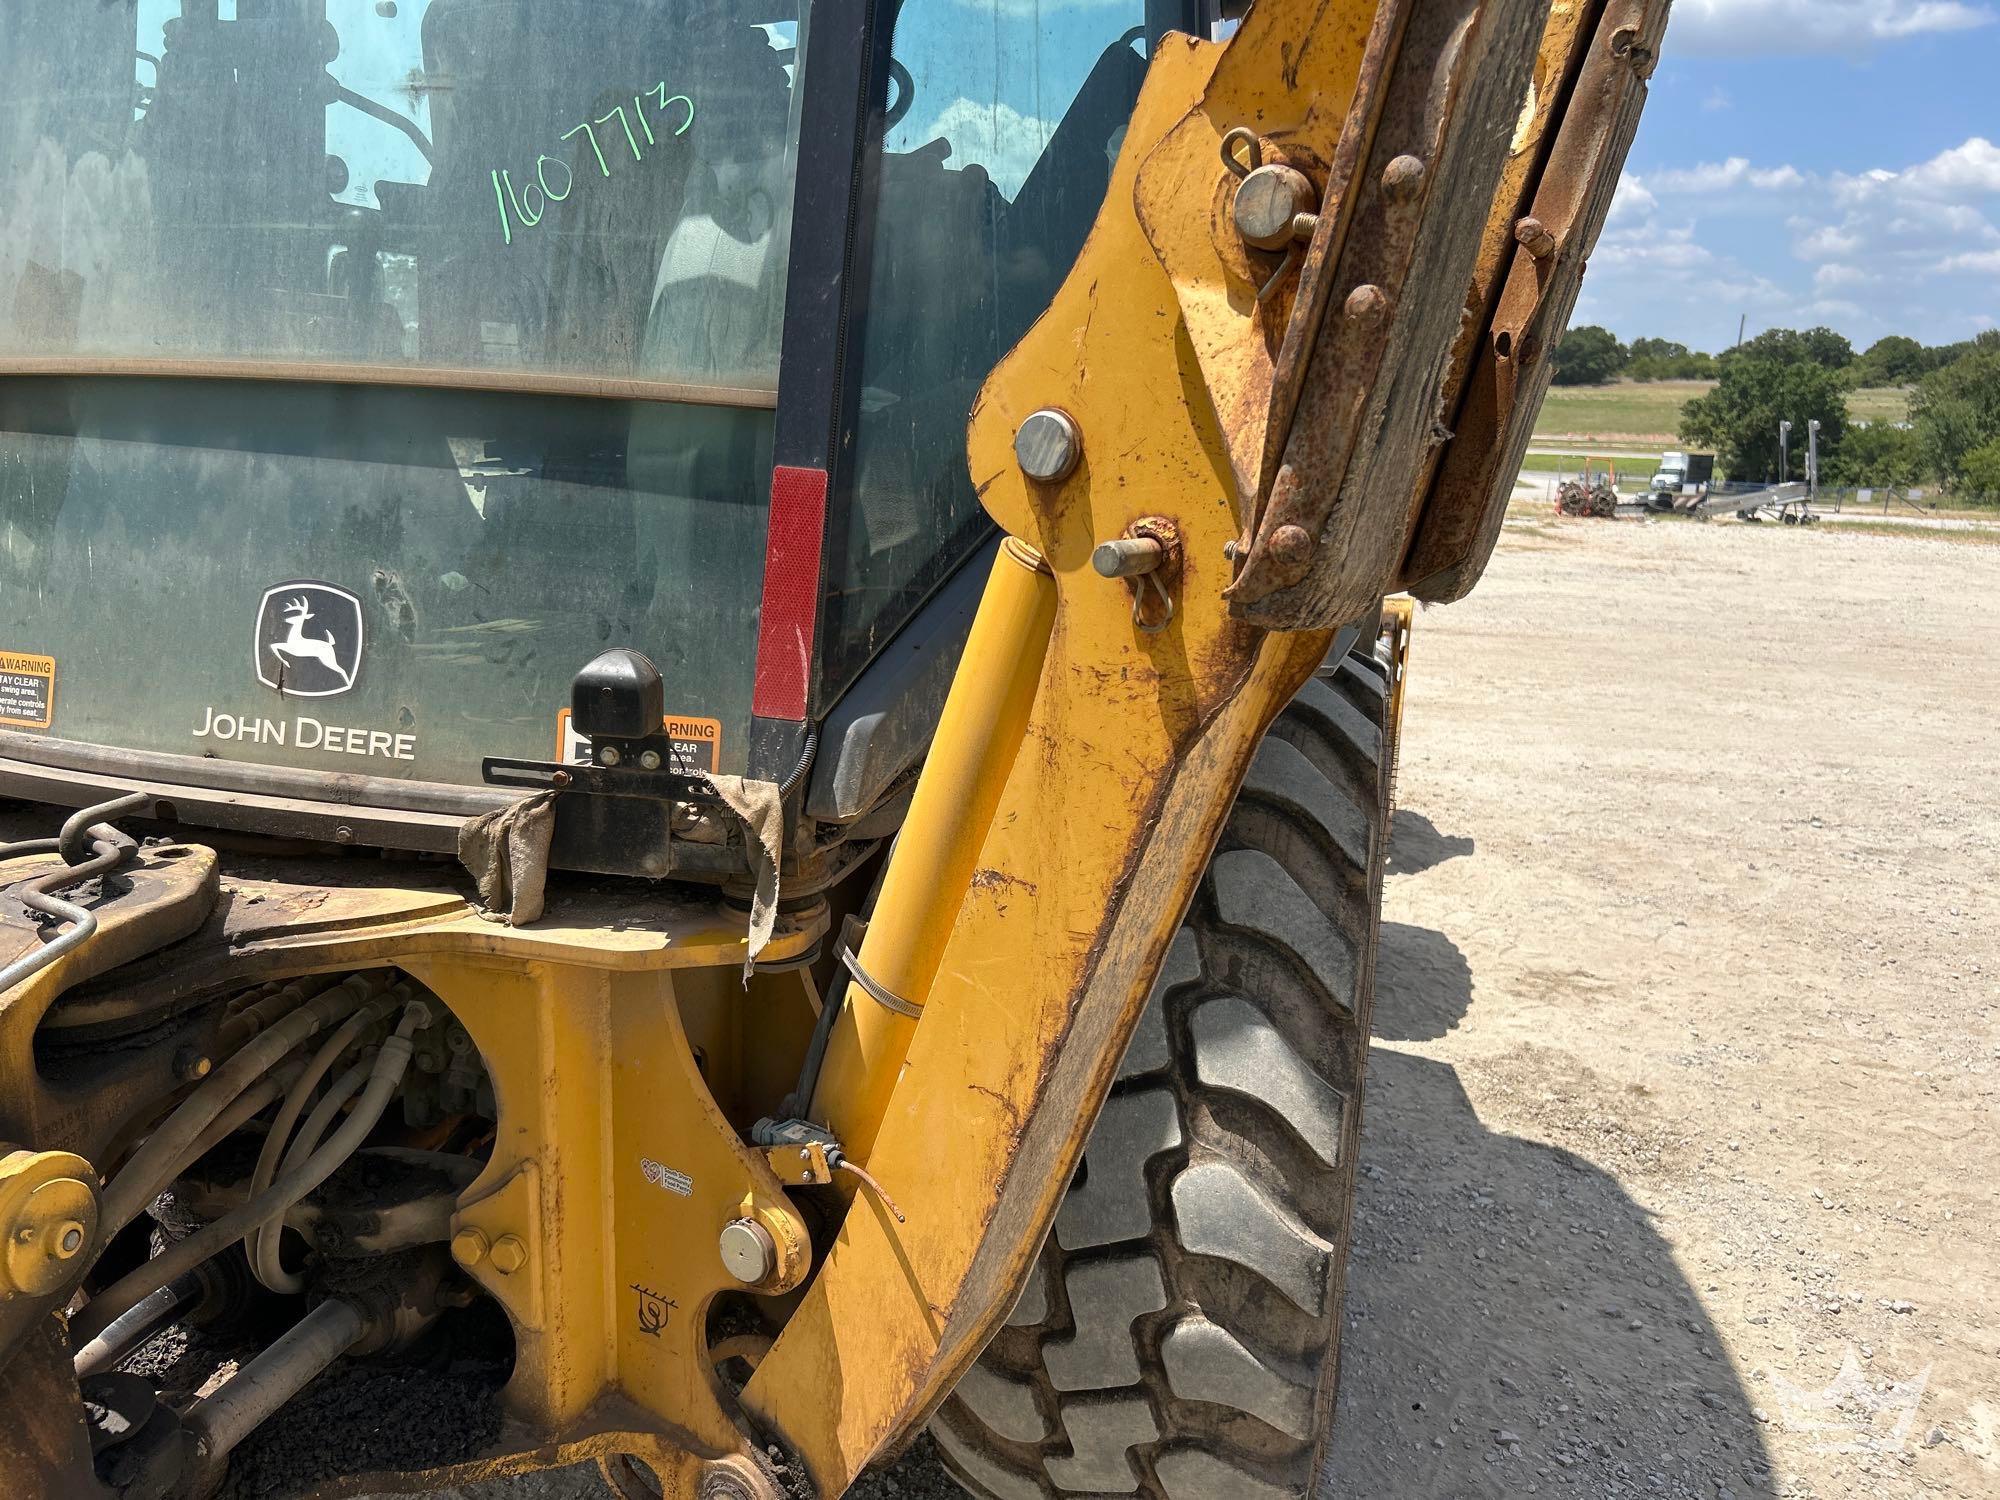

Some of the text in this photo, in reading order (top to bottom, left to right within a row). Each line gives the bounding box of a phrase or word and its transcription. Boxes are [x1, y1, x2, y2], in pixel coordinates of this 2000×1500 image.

[491, 81, 695, 245] 1607713
[6, 658, 51, 673] WARNING
[0, 675, 39, 687] TAY CLEAR
[1, 686, 37, 696] swing area.
[18, 700, 46, 709] controls
[6, 706, 22, 715] from
[22, 709, 39, 717] seat.
[192, 706, 417, 761] JOHN DEERE
